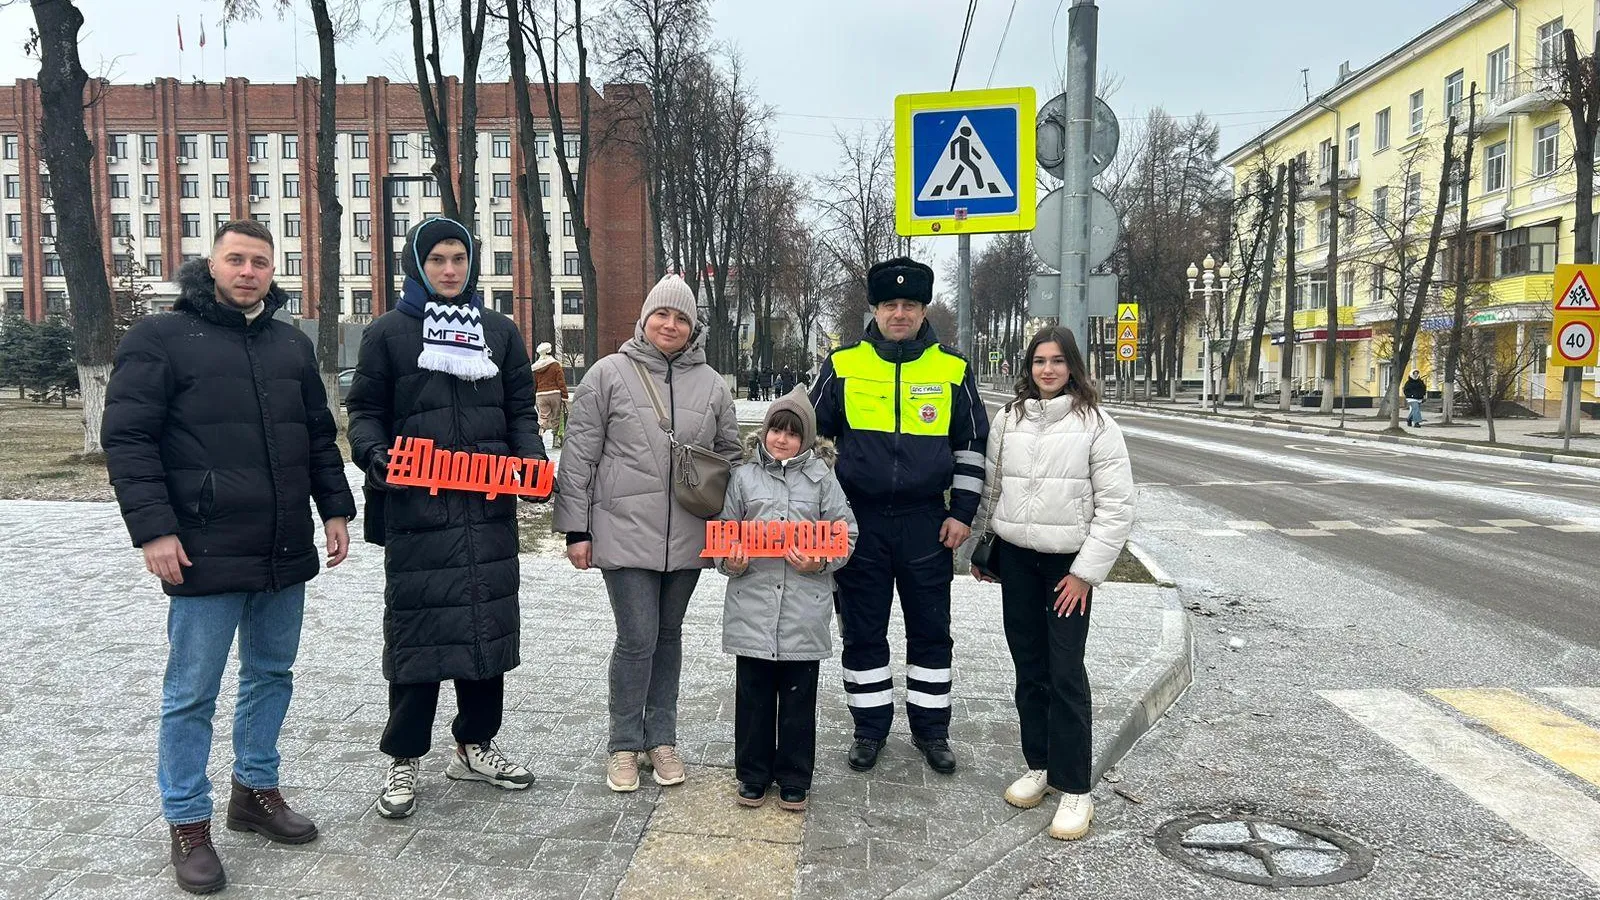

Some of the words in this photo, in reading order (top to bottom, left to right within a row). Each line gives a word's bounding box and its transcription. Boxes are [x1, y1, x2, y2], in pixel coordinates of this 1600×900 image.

[428, 328, 479, 342] МГЕР
[1566, 333, 1585, 348] 40
[386, 436, 556, 500] #Пропусти
[700, 520, 849, 562] пешехода
